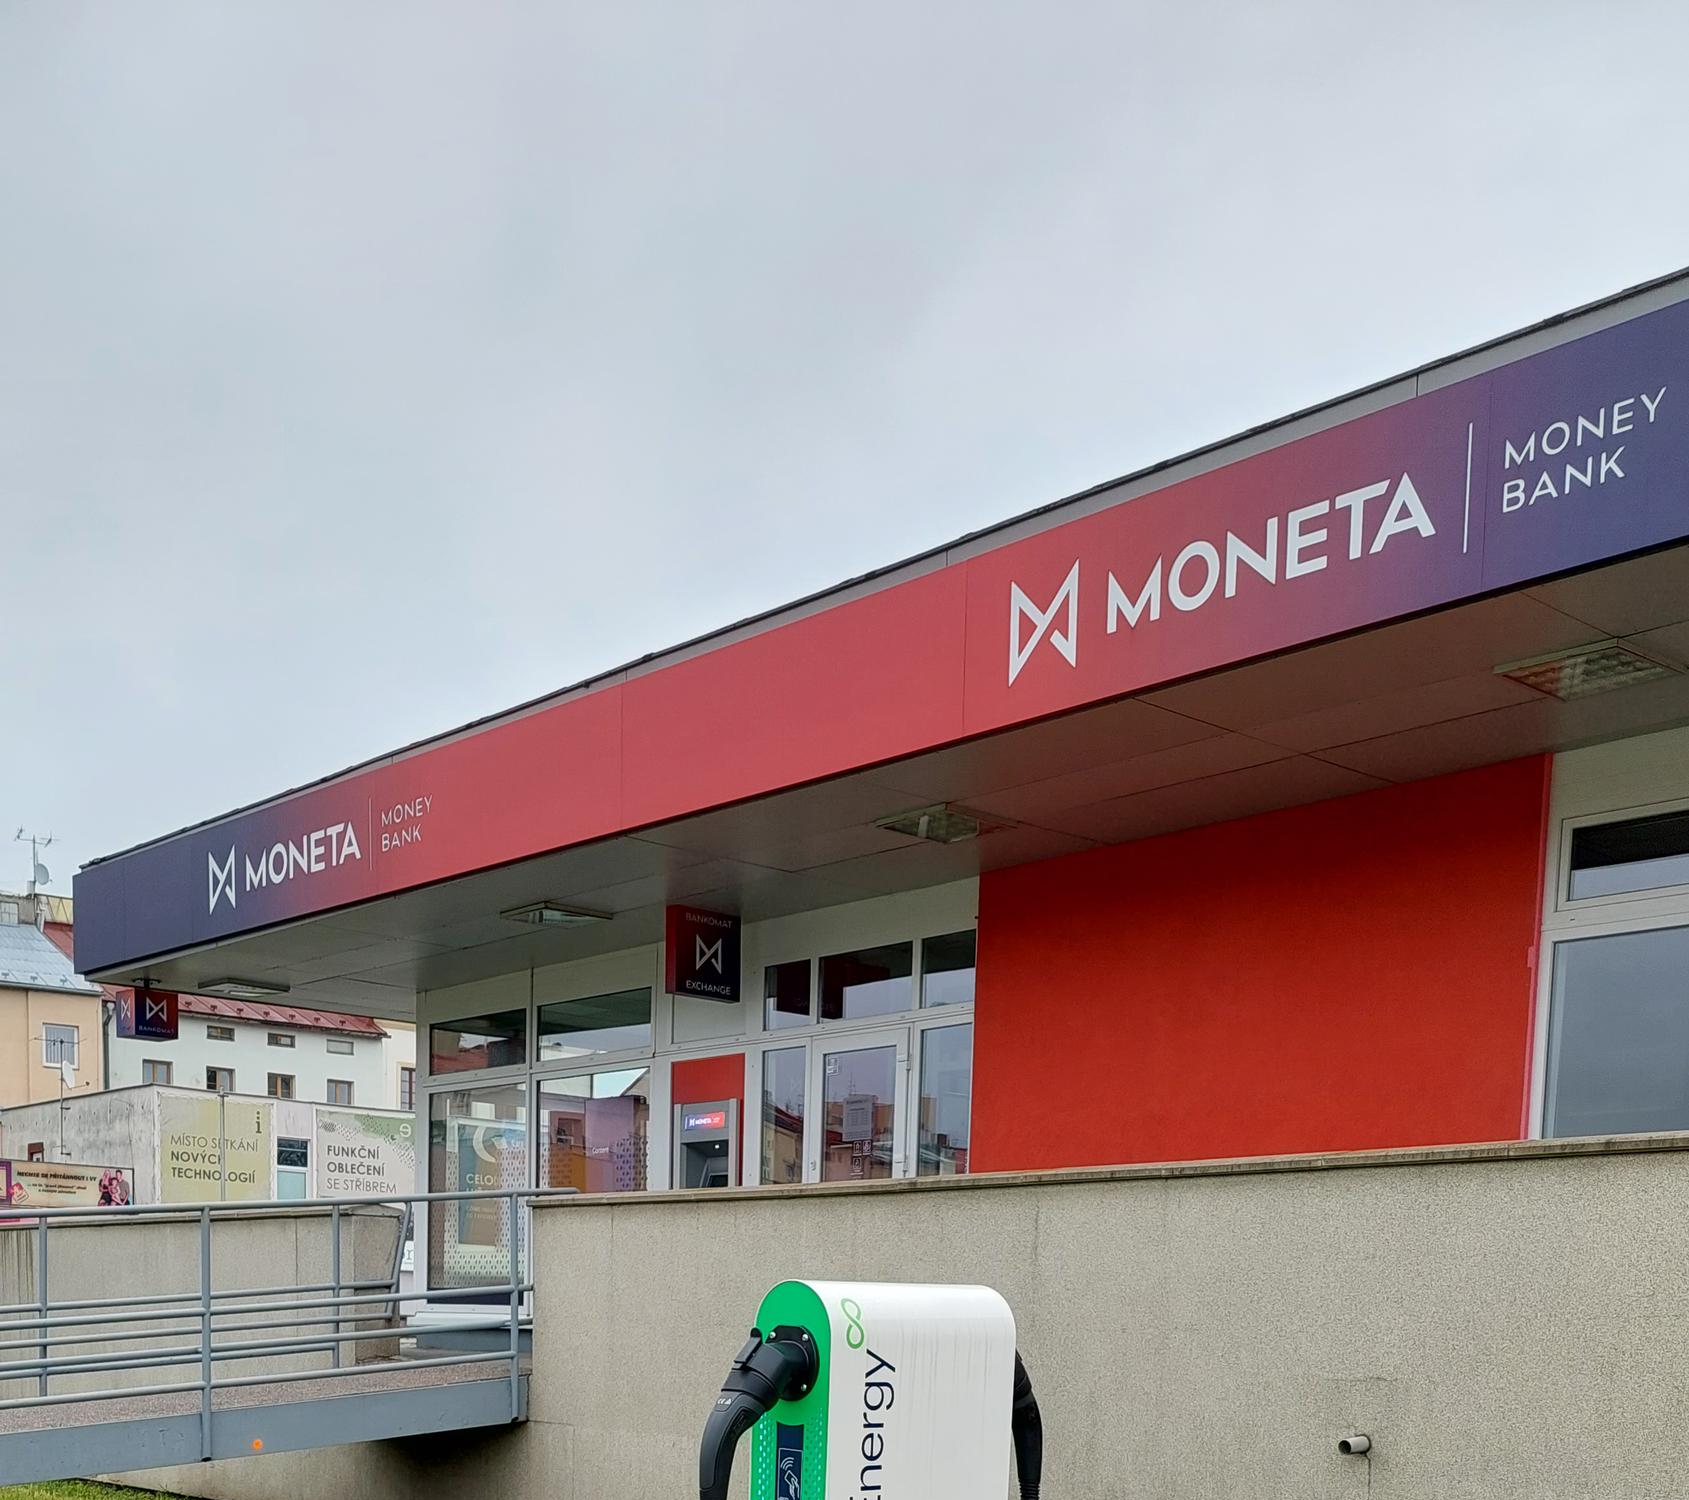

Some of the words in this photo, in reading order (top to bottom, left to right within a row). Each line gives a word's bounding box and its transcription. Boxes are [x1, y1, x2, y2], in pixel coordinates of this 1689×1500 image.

[1503, 386, 1667, 470] MONEY
[1501, 446, 1626, 514] BANK
[1105, 471, 1437, 635] MONETA
[381, 794, 433, 828] MONEY
[381, 823, 422, 852] BANK
[245, 821, 362, 892] MONETA
[685, 912, 732, 928] BANKOMAT
[685, 980, 731, 995] EXCHANGE
[170, 1132, 208, 1148] MÍSTO
[327, 1145, 380, 1160] FUNKČNÍ
[171, 1167, 256, 1184] TECHNOOGIÍ
[327, 1161, 385, 1177] OBLEČENÍ
[326, 1178, 340, 1190] SE
[343, 1177, 397, 1194] STŘÍBREM
